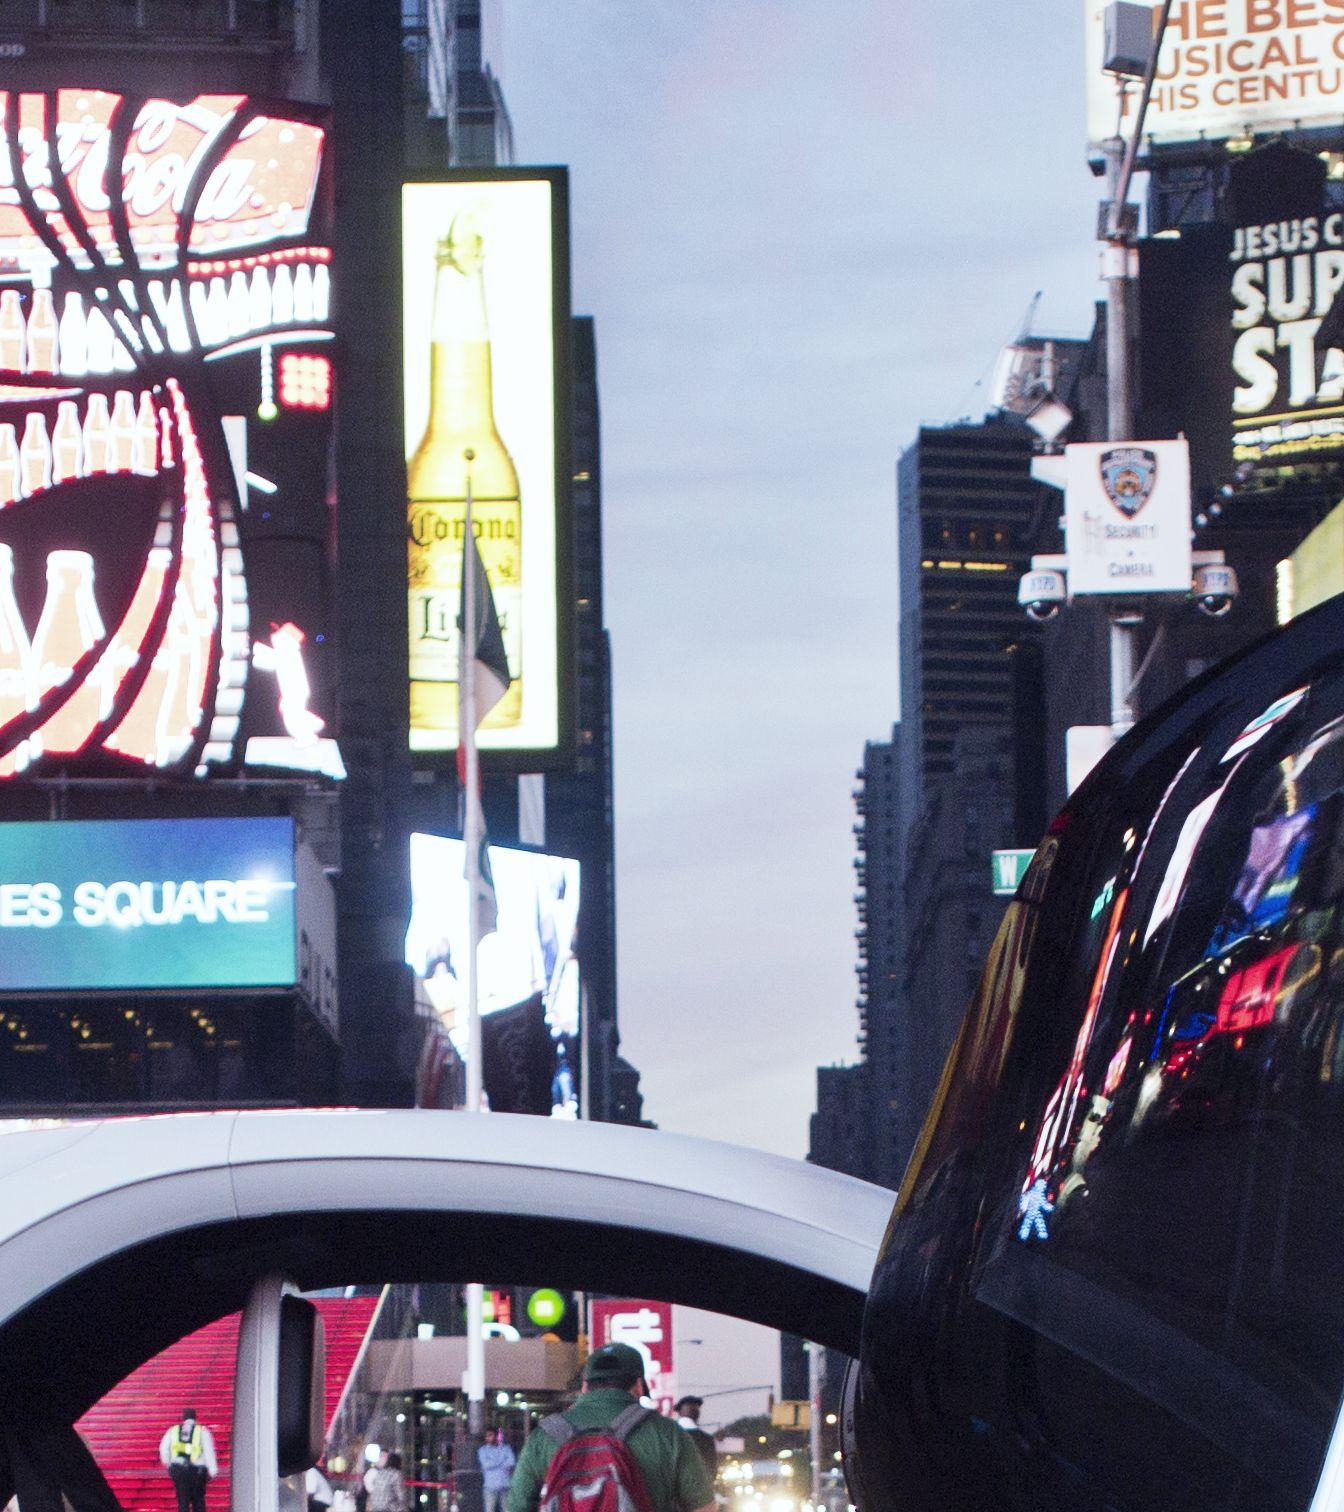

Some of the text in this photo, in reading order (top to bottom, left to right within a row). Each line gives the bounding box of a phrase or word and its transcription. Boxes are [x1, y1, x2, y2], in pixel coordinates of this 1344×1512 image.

[1152, 0, 1227, 40] HE
[1229, 217, 1318, 261] JESUS
[999, 855, 1018, 887] W
[73, 878, 271, 926] SQUARE
